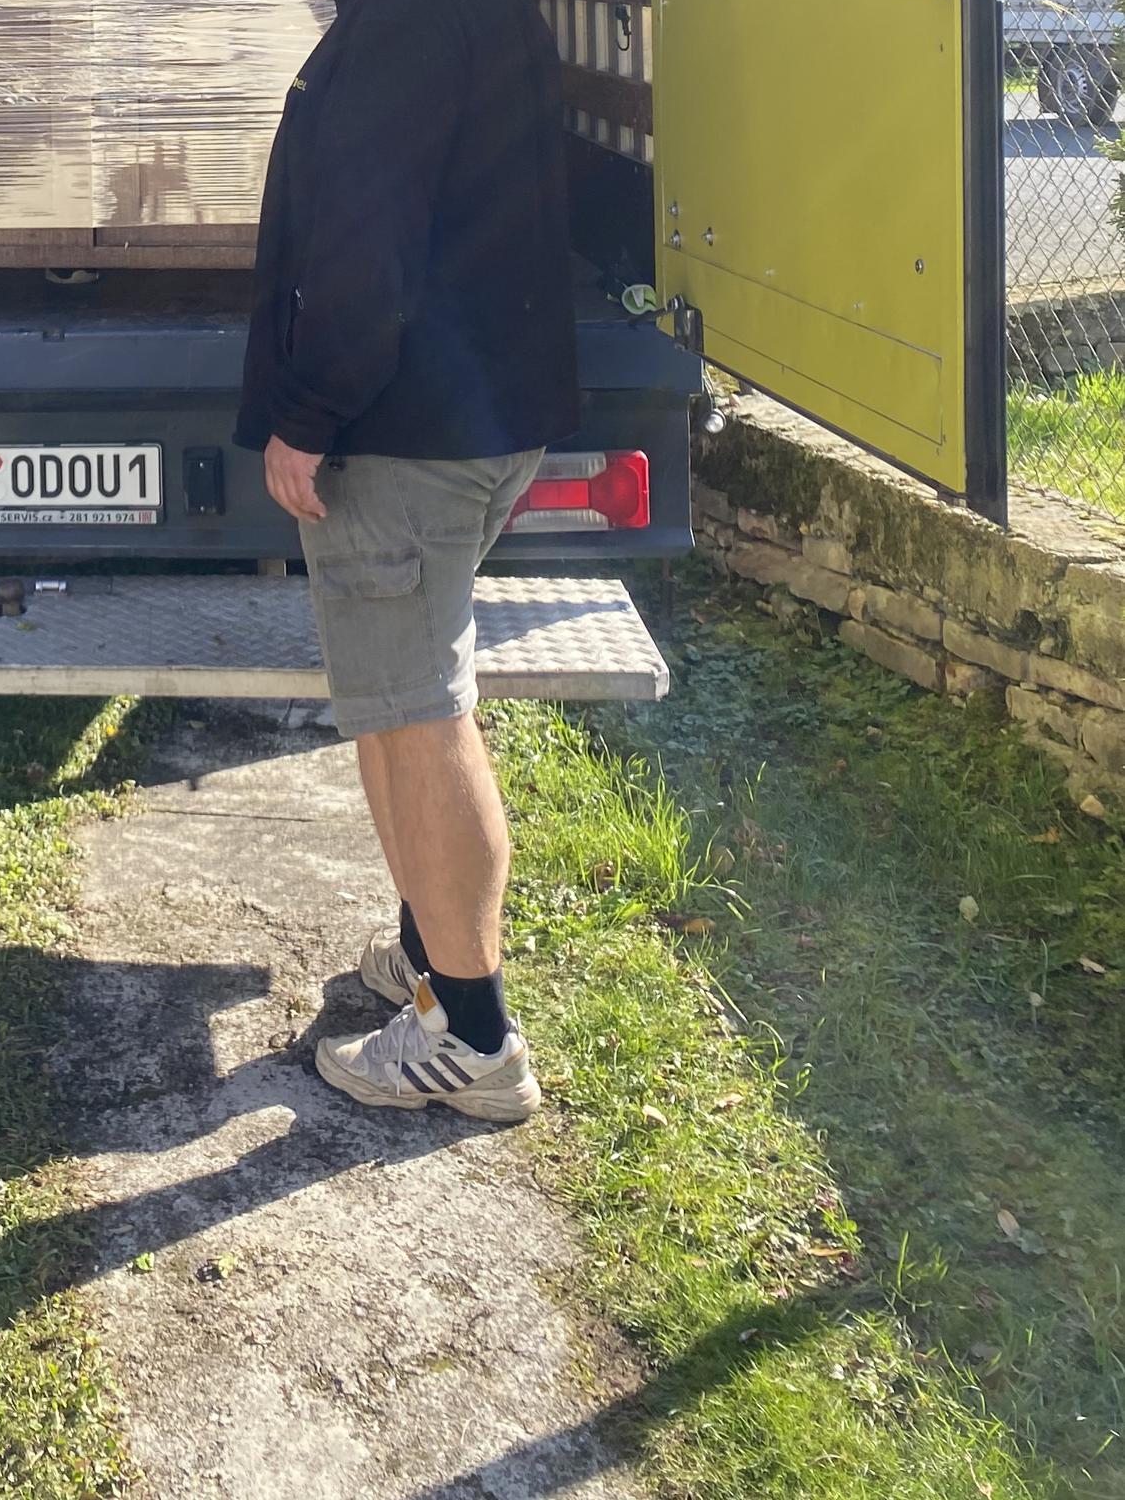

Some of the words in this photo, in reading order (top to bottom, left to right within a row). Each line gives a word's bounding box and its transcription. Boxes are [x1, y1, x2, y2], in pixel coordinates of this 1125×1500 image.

[69, 512, 88, 522] 281
[92, 512, 111, 522] 921
[115, 512, 135, 522] 974
